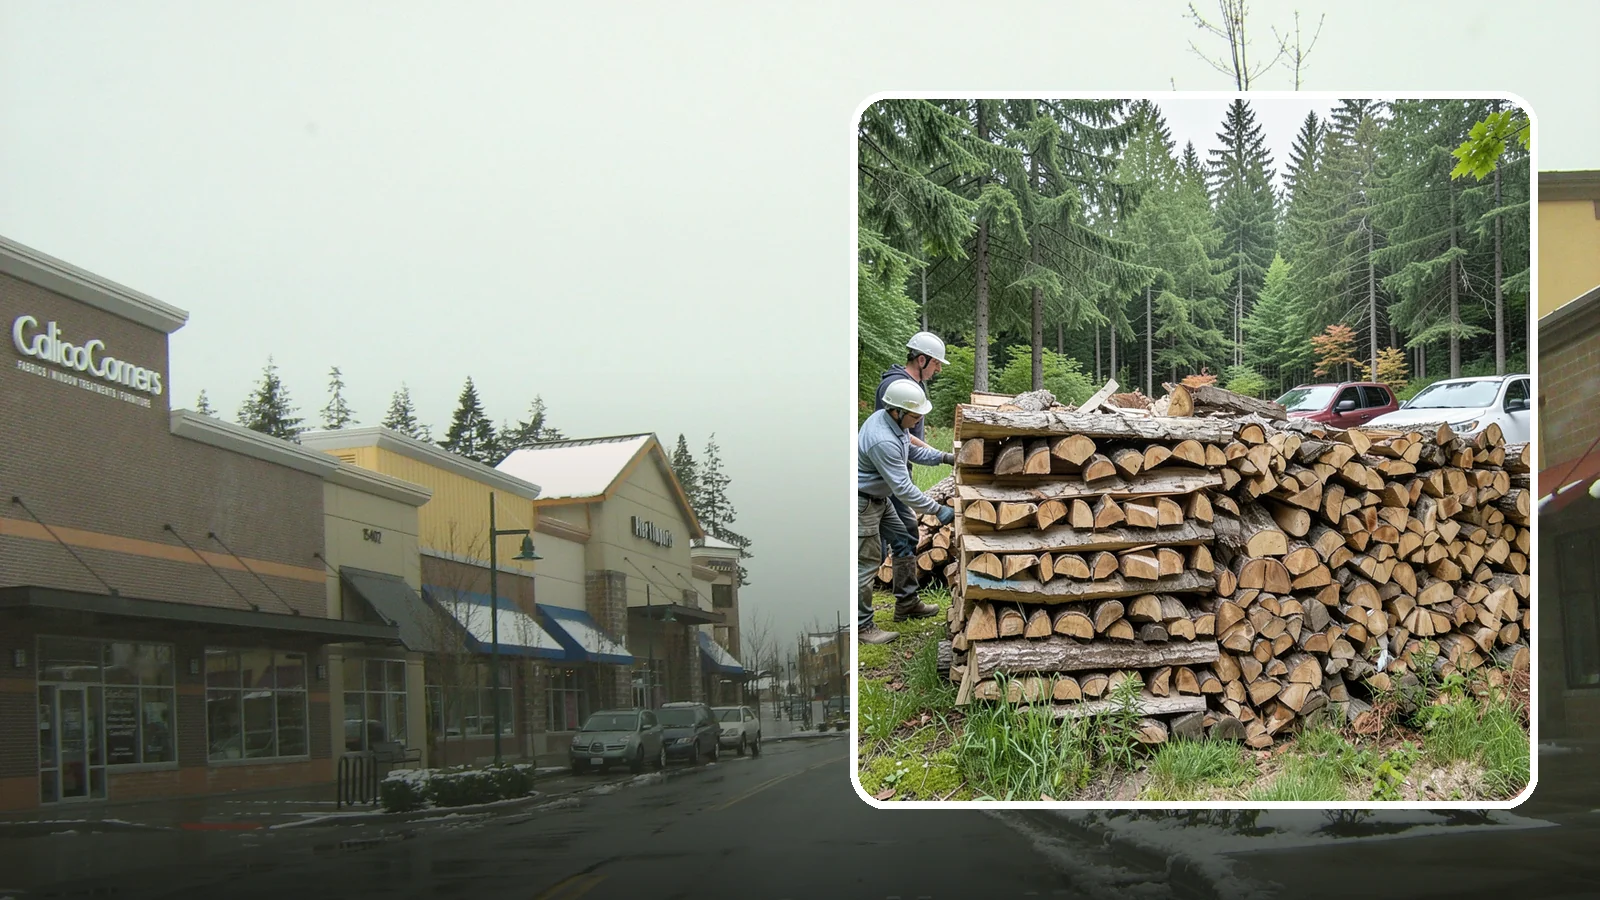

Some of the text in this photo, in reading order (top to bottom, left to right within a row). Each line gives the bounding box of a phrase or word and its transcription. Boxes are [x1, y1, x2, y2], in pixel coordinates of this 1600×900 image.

[16, 360, 47, 377] FABRICS
[51, 370, 78, 386] WINDOW
[78, 378, 116, 398] TREATMENTS
[120, 391, 151, 409] FURNITURE
